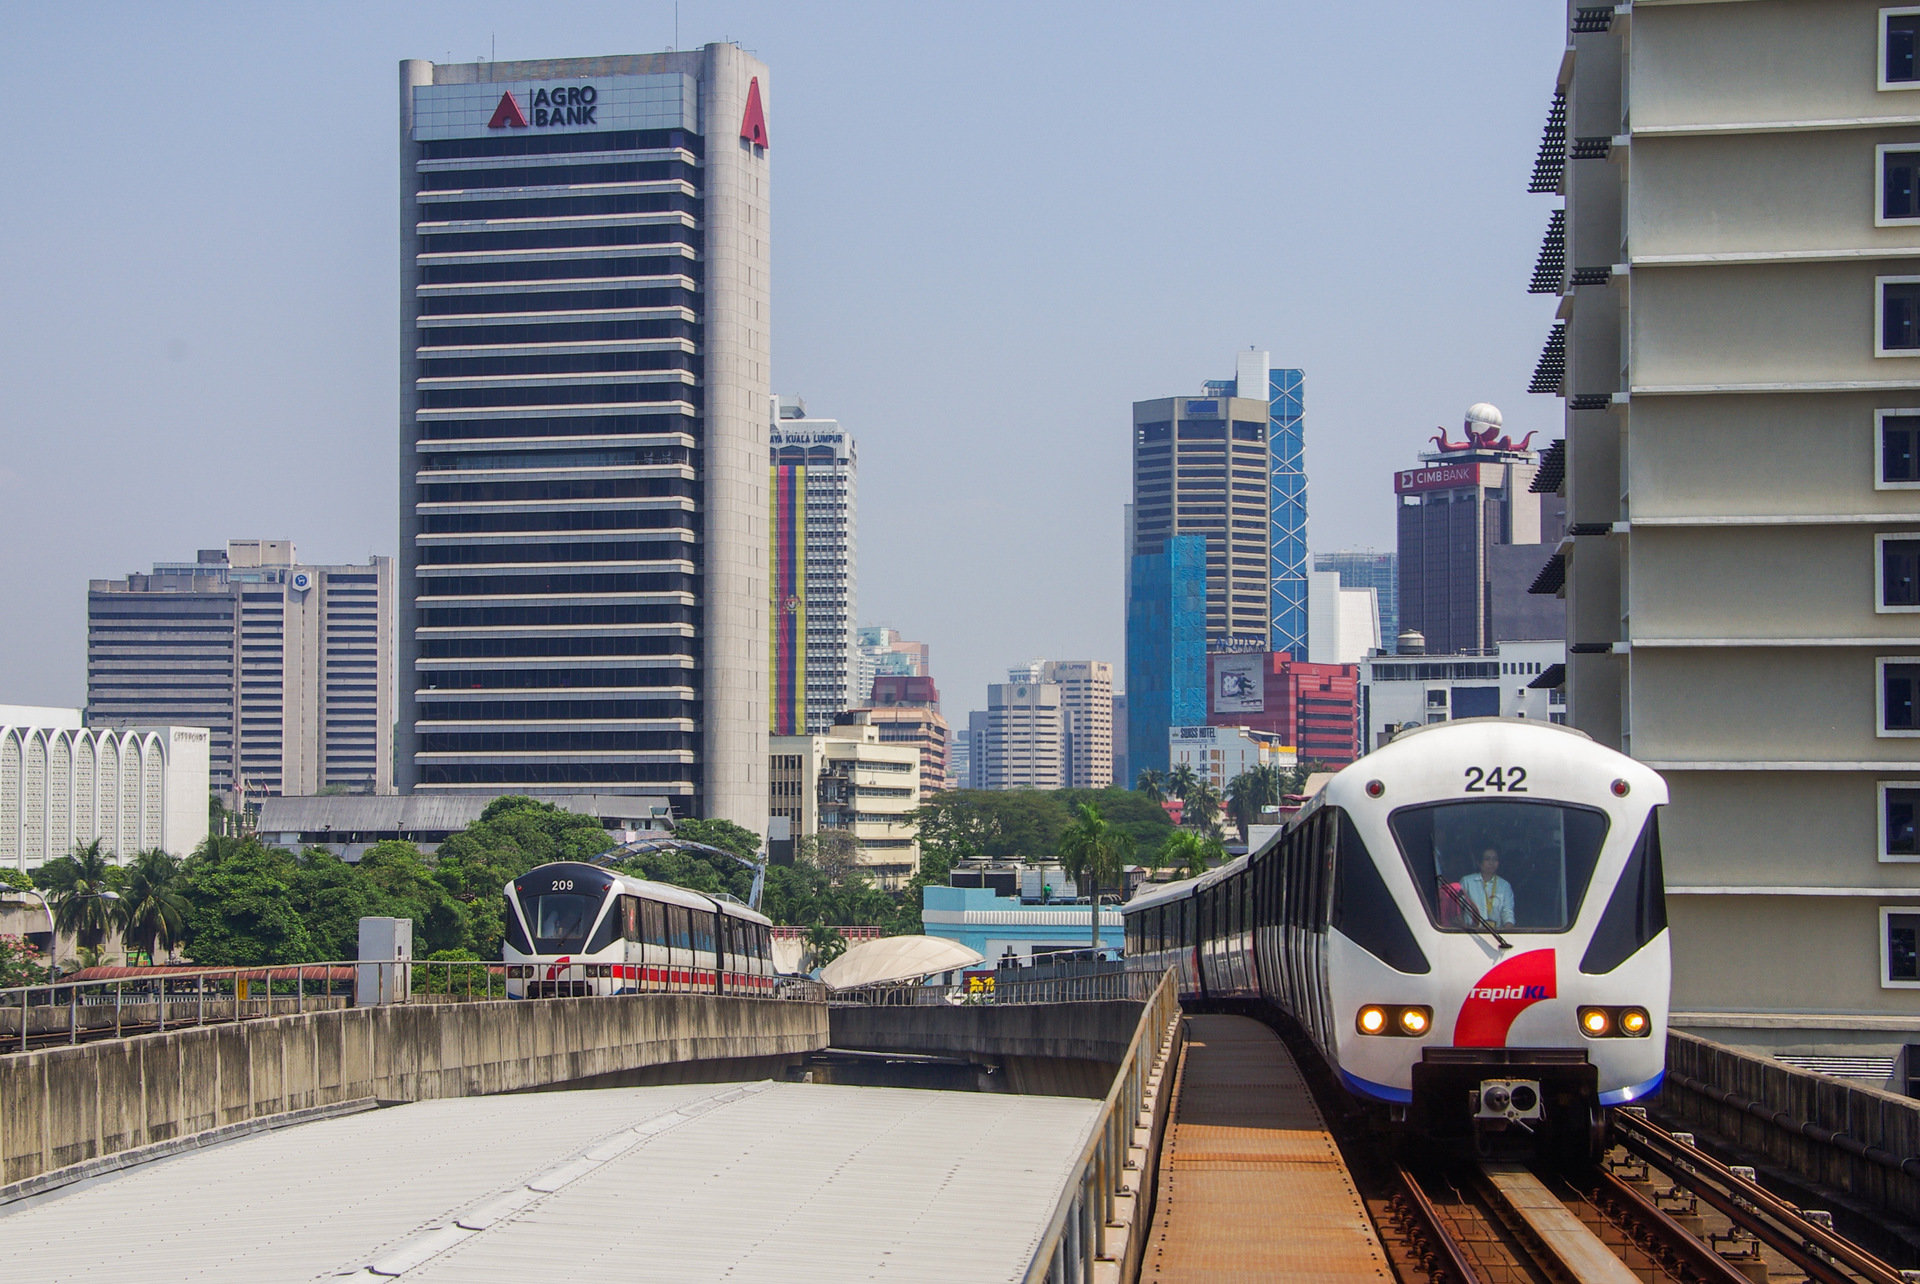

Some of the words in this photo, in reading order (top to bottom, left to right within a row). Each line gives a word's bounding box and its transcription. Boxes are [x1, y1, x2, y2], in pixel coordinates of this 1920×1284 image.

[534, 85, 597, 107] AGRO
[535, 105, 597, 127] BANK
[786, 434, 811, 444] KUALA
[813, 434, 843, 444] LUMPUR
[1416, 471, 1442, 484] CIMB
[1443, 467, 1470, 481] BANK
[1180, 727, 1198, 738] SWISS
[1199, 727, 1216, 738] HOTEL
[1464, 766, 1528, 792] 242
[551, 879, 574, 891] 209
[1469, 985, 1549, 1003] rapidKL
